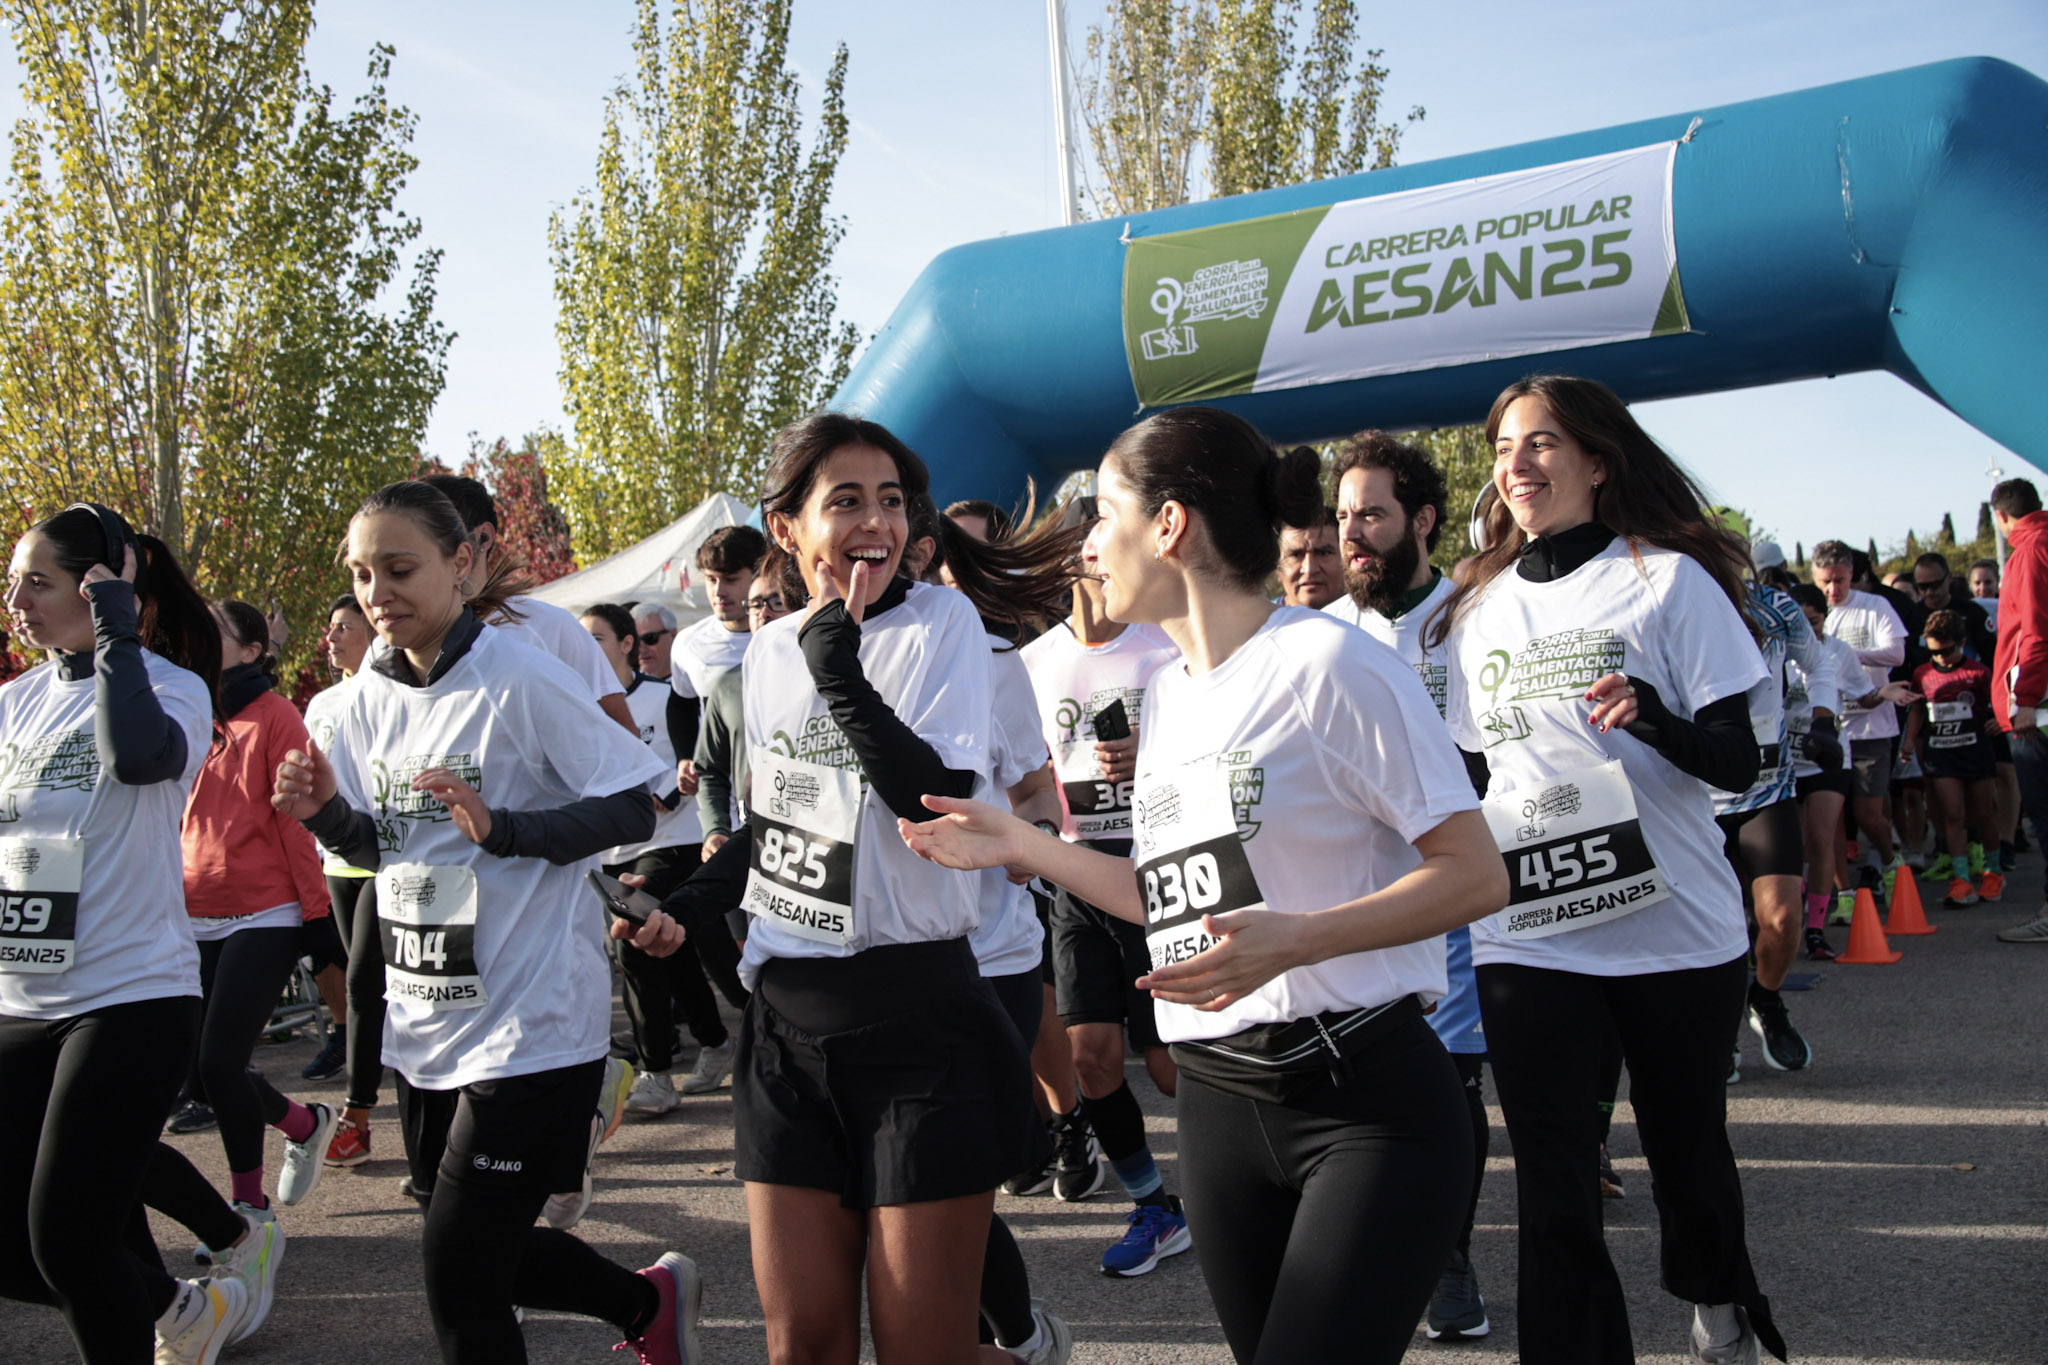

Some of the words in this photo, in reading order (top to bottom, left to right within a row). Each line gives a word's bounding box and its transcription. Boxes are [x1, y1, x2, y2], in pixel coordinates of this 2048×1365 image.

[1325, 225, 1468, 268] CARRERA
[1475, 195, 1632, 244] POPULAR
[1195, 262, 1237, 281] CORRE
[1304, 229, 1632, 334] AESAN25
[1192, 290, 1261, 317] SALUDABLE
[1527, 629, 1583, 651] CORRE
[1583, 631, 1600, 642] CON
[1602, 630, 1614, 639] LA
[1586, 644, 1599, 654] DE
[1601, 643, 1624, 653] UNA
[1936, 721, 1962, 735] 727
[34, 730, 79, 747] CORRE
[444, 756, 458, 765] CON
[460, 755, 470, 764] LA
[20, 764, 98, 783] SALUDABLE
[461, 768, 480, 778] UNA
[1235, 769, 1262, 784] UNA
[760, 828, 830, 890] 825
[1520, 833, 1618, 891] 455
[1145, 852, 1222, 924] 830
[1510, 907, 1554, 924] CARRERA
[1555, 879, 1657, 922] AESAN25
[769, 895, 845, 933] AESAN25
[1508, 916, 1553, 933] POPULAR
[0, 946, 66, 963] ESAN25
[392, 926, 448, 970] 704
[407, 983, 478, 1002] AESAN25
[490, 1159, 523, 1172] JAKO
